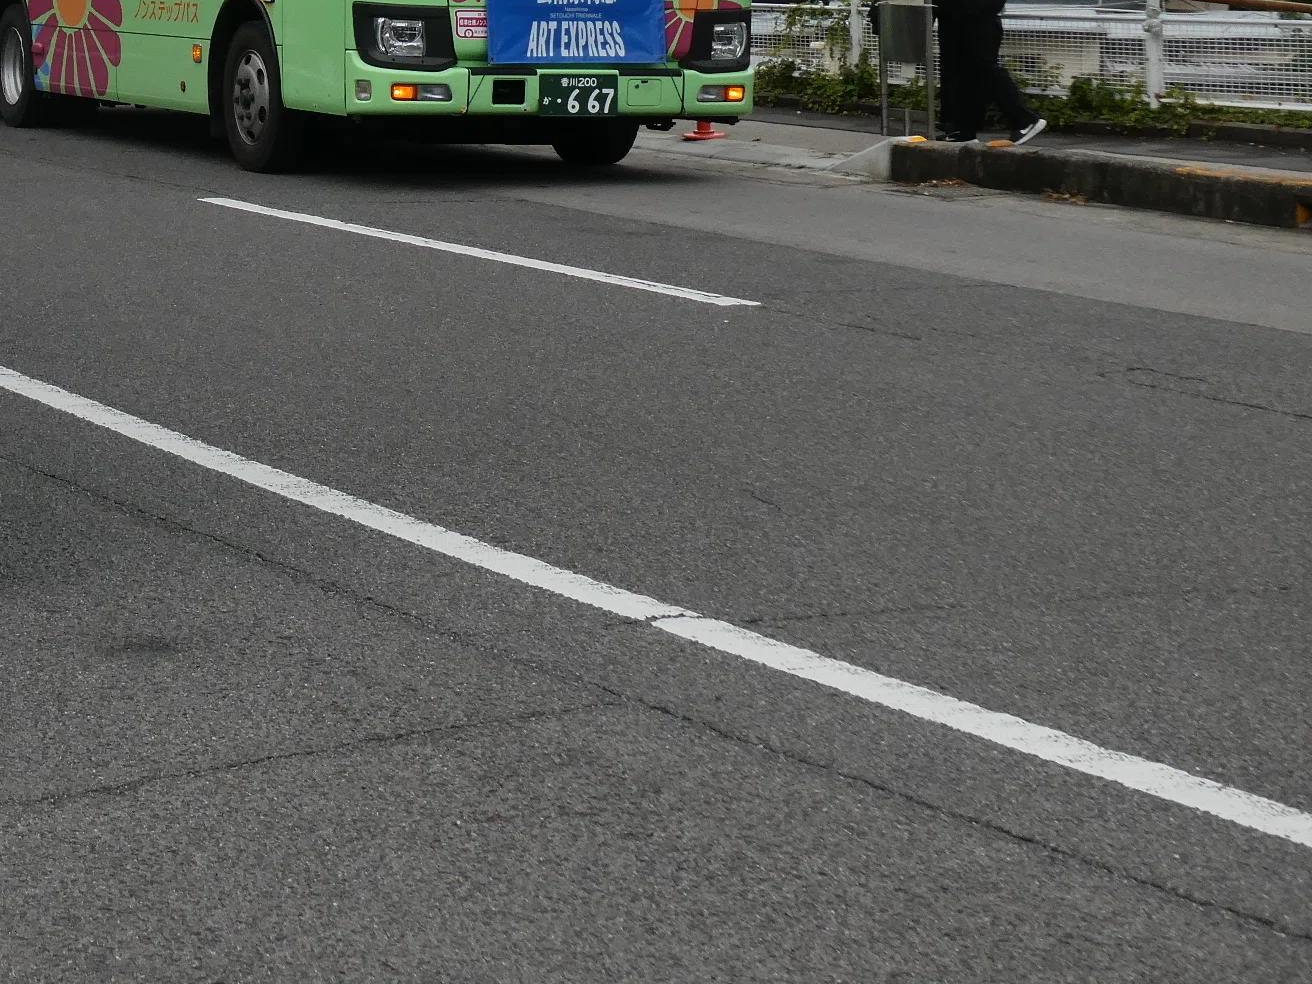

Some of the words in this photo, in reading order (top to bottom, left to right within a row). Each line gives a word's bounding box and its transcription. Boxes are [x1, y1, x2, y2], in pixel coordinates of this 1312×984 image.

[134, 0, 200, 23] ノンステップバス
[526, 21, 558, 58] ART
[560, 20, 627, 58] EXPRESS
